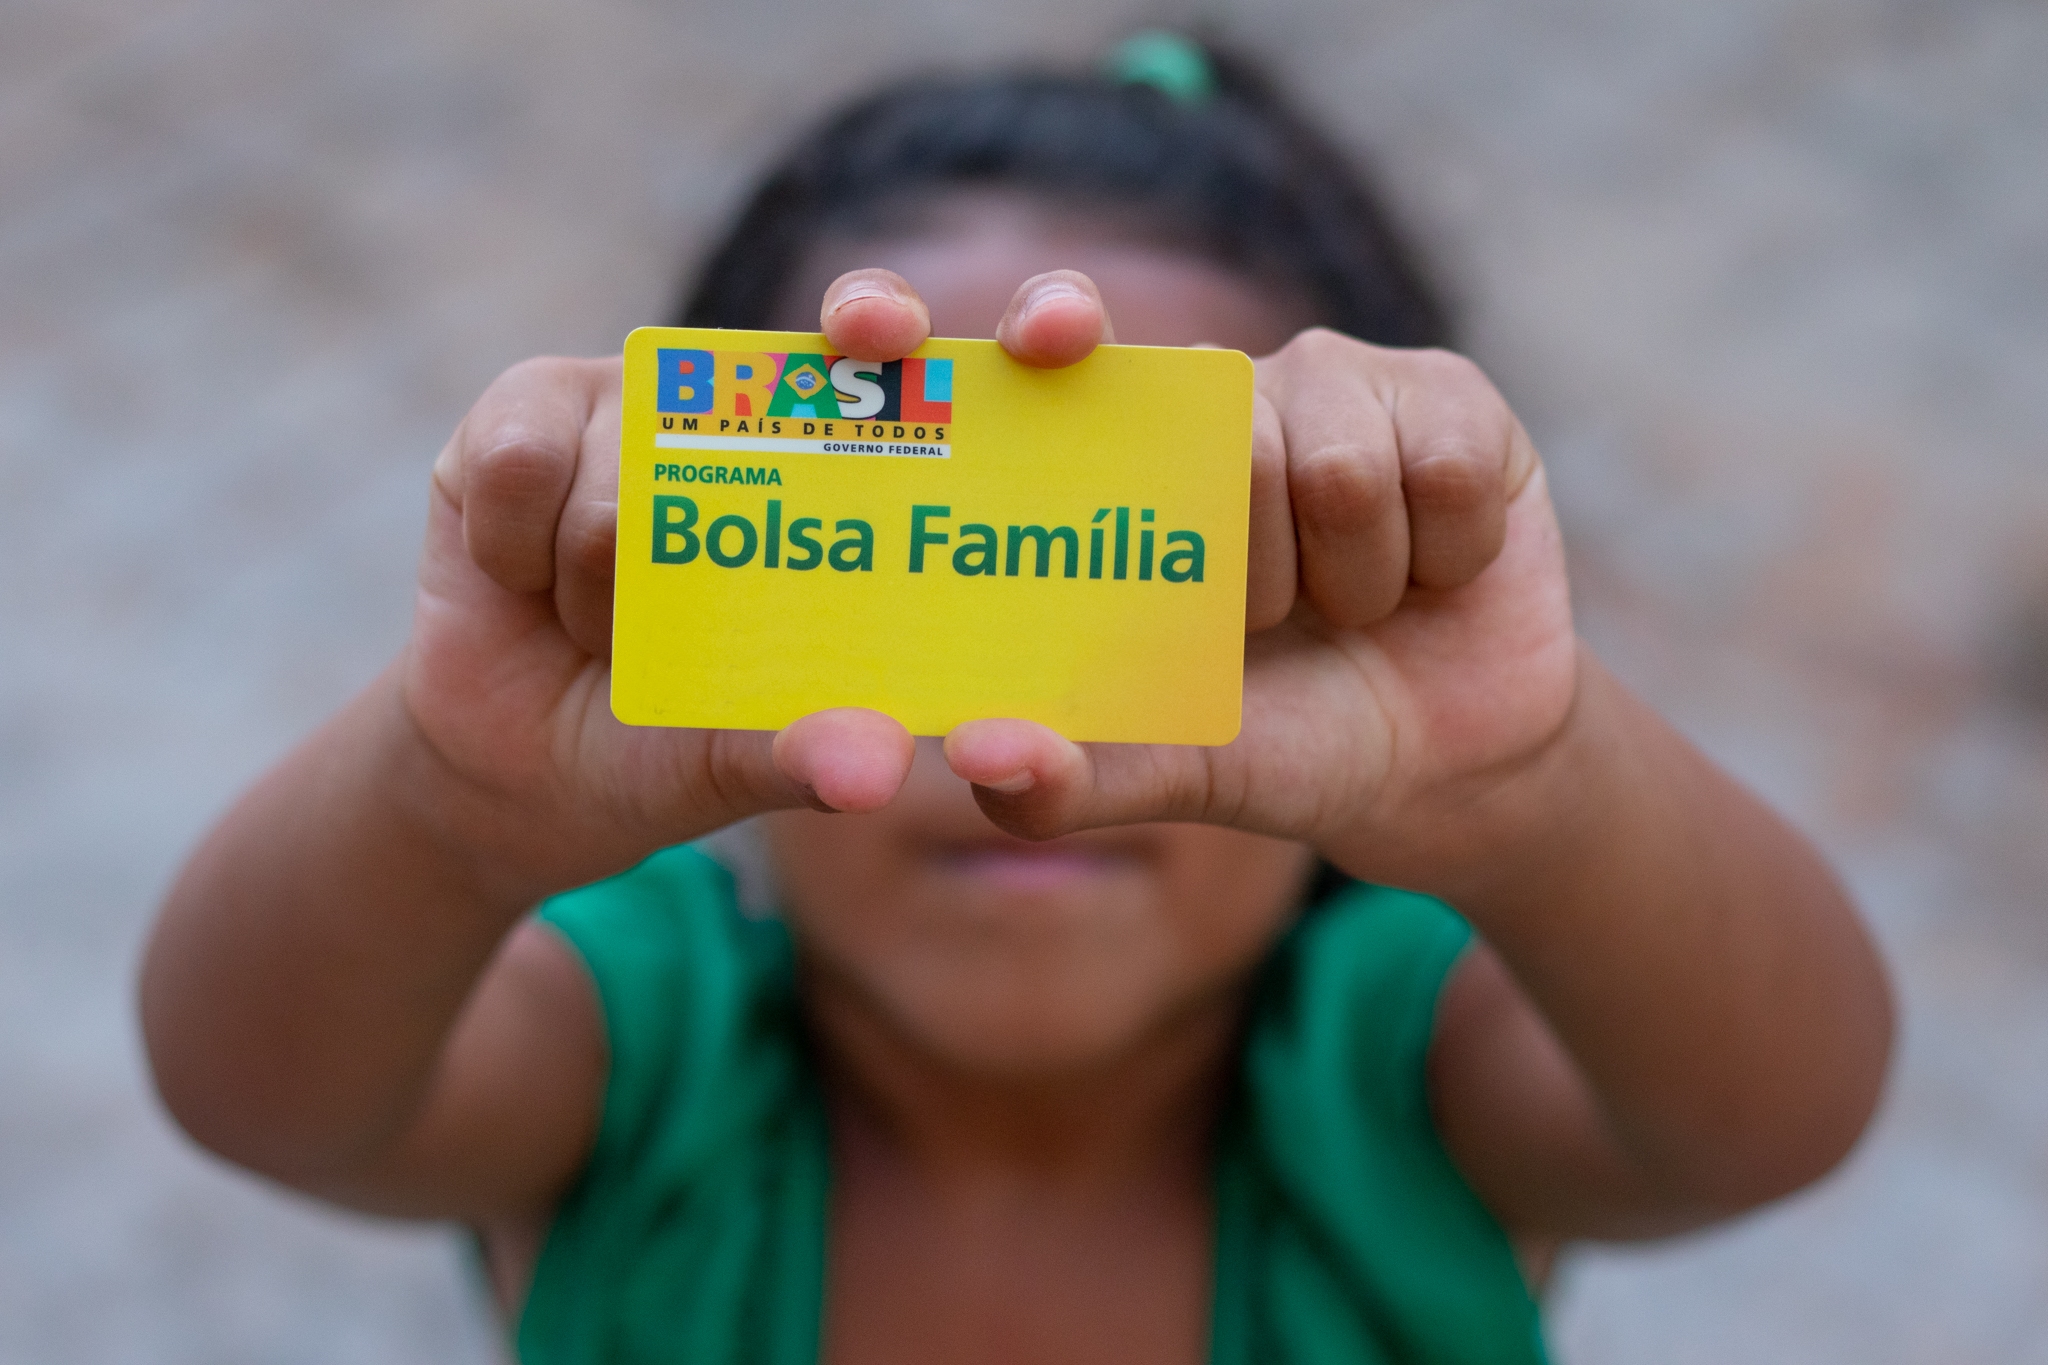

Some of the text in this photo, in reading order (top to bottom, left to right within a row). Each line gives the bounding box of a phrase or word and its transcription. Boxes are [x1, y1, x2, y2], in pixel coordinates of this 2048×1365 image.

[657, 348, 952, 424] BRASIL
[662, 417, 945, 440] UM PAÍS DE TODOS
[823, 443, 943, 456] GOVERNO FEDERAL
[654, 463, 782, 487] PROGRAMA
[651, 494, 1206, 583] Bolsa Família
